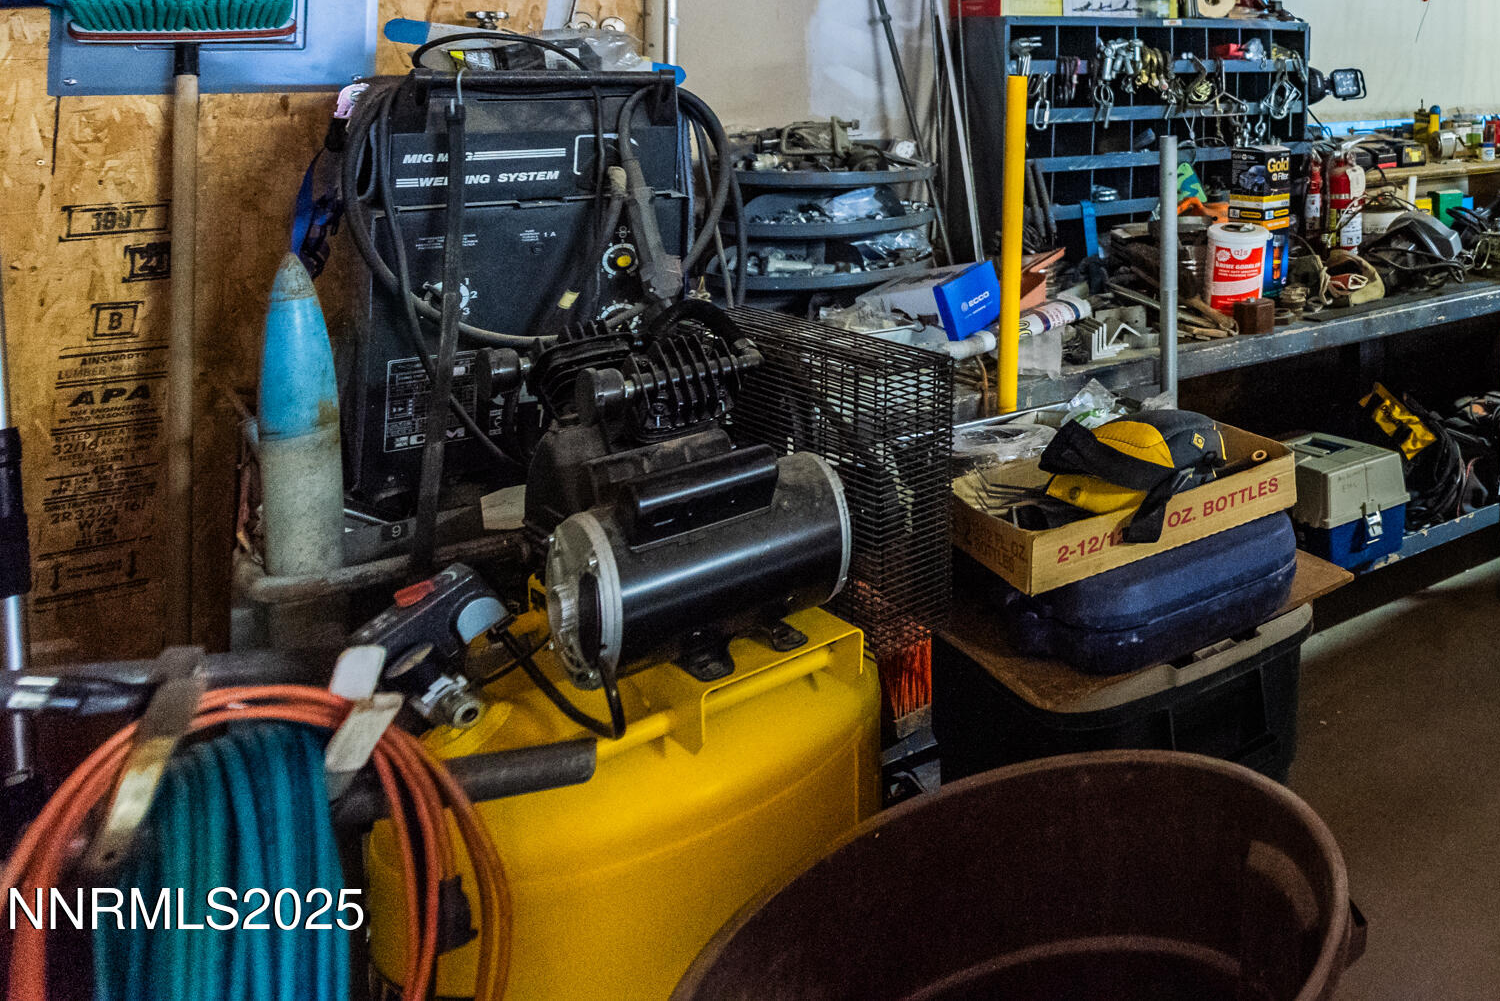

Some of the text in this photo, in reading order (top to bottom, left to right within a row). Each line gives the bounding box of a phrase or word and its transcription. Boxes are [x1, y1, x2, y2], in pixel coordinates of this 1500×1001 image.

[402, 153, 434, 164] MIG
[1267, 156, 1290, 173] Gold
[418, 170, 560, 188] WEING SYSTEM
[91, 210, 148, 231] 1997
[968, 290, 990, 307] ECCO
[107, 311, 123, 331] B
[57, 365, 107, 381] LUMBER
[67, 383, 151, 408] APA
[1167, 507, 1197, 529] OZ.
[1203, 477, 1280, 517] BOTTLES
